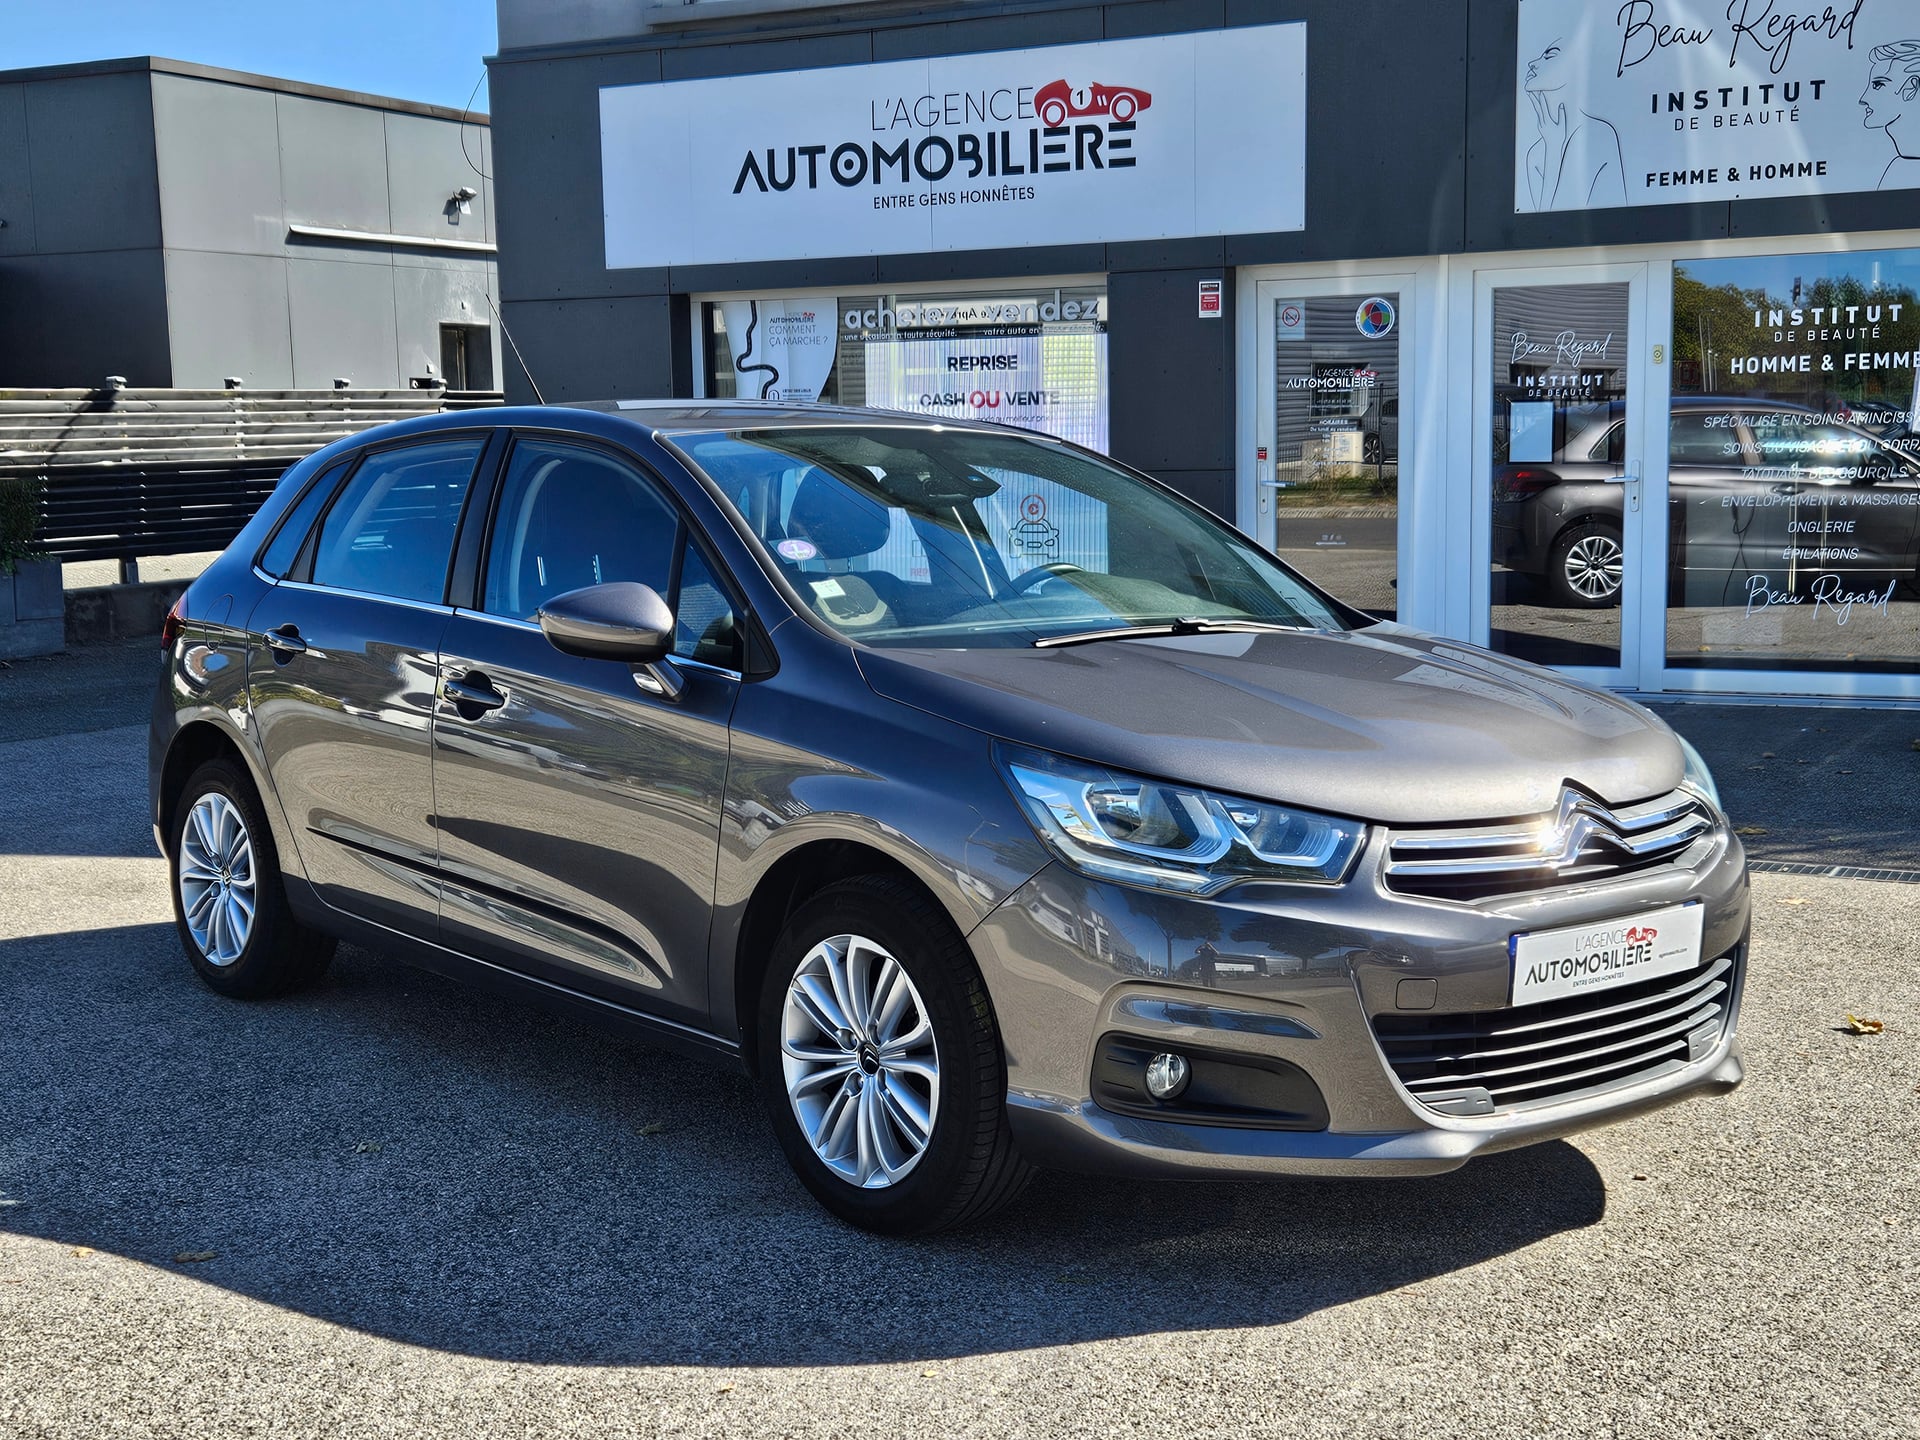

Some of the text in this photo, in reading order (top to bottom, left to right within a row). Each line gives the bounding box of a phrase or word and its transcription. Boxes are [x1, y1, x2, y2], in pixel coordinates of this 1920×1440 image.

[1617, 0, 1863, 77] Beau Regard
[1651, 79, 1826, 114] INSTITUT
[871, 86, 1034, 133] L'AGENCE
[1674, 104, 1801, 131] DE BEAUTÉ
[1646, 160, 1828, 188] FEMME & HOMME
[873, 184, 1035, 210] ENTRE GENS HONNÊTES
[844, 288, 1100, 330] achetez vendez
[1754, 303, 1903, 328] INSTITUT
[768, 324, 817, 335] COMMENT
[1774, 324, 1881, 343] DE BEAUTÉ
[783, 336, 821, 346] MARCHE
[1510, 330, 1613, 368] Beau Regard
[947, 354, 1018, 372] REPRISE
[1730, 351, 1920, 374] HOMME & FEMME
[1516, 374, 1604, 387] INSTITUT
[920, 390, 1061, 409] CASH OU VENTE
[1528, 386, 1591, 398] DE BEAUTÉ
[1703, 412, 1779, 428] SPÉCIALISÉ
[1782, 414, 1801, 426] EN
[1803, 412, 1845, 426] SOINS
[1722, 441, 1762, 455] SOINS
[1881, 438, 1920, 452] CORP
[1721, 494, 1836, 508] ENVELOPPEMENT
[1838, 494, 1848, 506] &
[1787, 520, 1856, 534] ONGLERIE
[1782, 545, 1860, 560] ÉPILATIONS
[1745, 573, 1897, 626] Beau Regard
[1575, 928, 1628, 952] L'AGENCE
